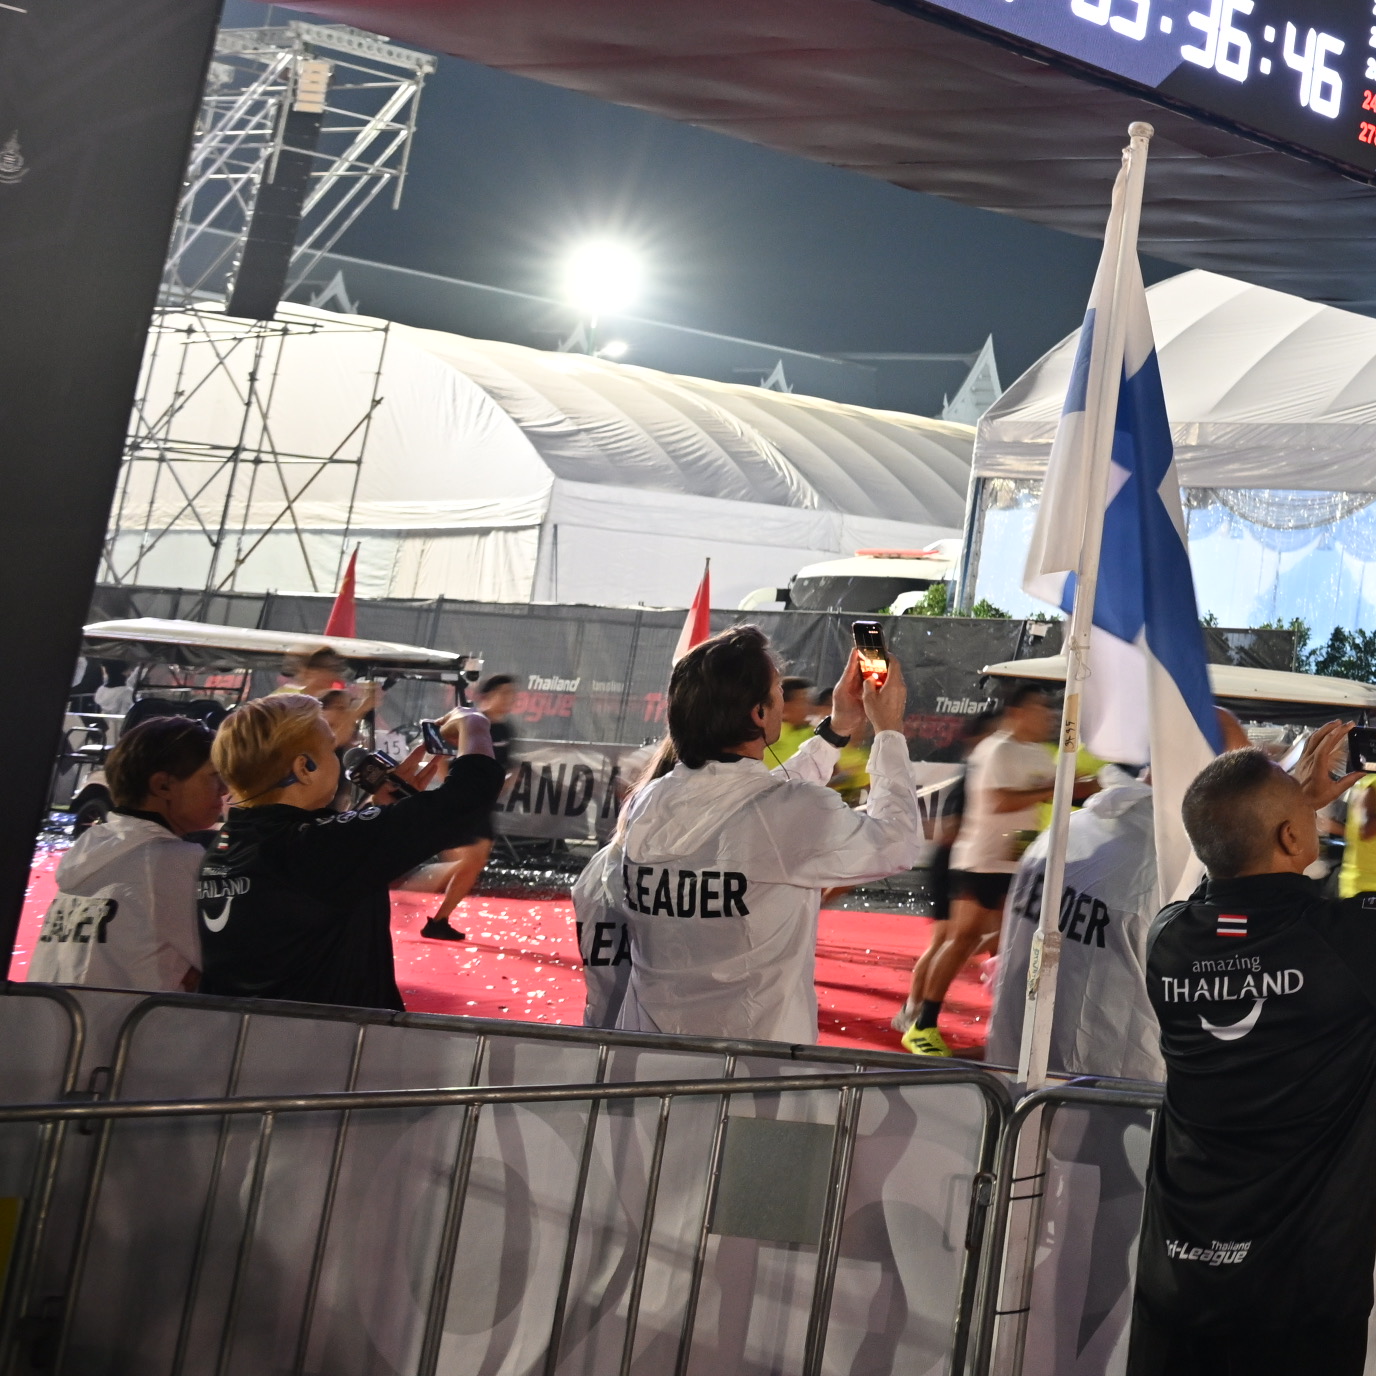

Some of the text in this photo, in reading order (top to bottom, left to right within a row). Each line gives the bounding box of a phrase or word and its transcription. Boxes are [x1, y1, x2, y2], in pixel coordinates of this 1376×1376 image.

[528, 675, 581, 693] Thailand
[623, 864, 750, 918] LEADER
[1013, 871, 1111, 949] LEDER
[1192, 954, 1261, 972] amazing
[1161, 969, 1304, 1002] THAILAND
[1211, 1240, 1252, 1252] Thailand
